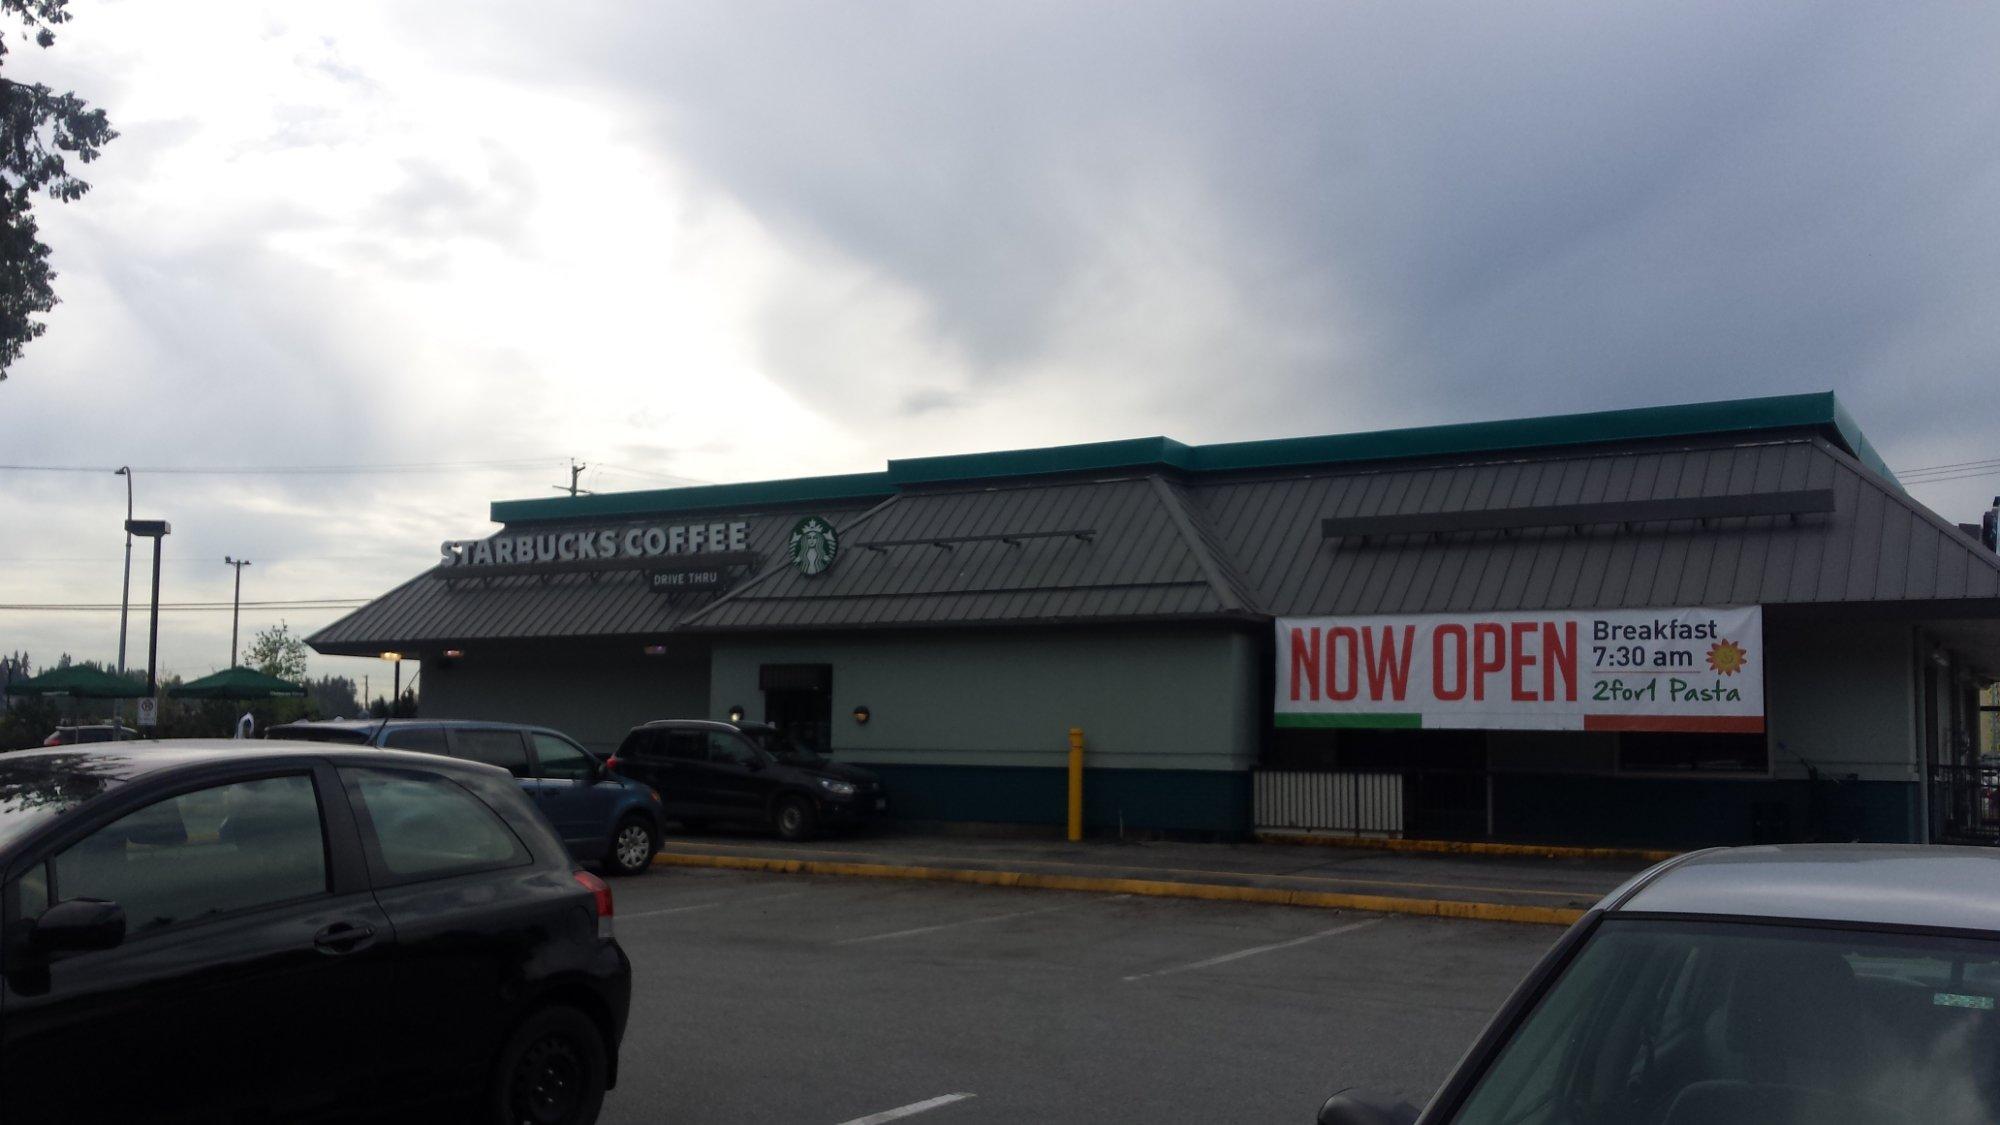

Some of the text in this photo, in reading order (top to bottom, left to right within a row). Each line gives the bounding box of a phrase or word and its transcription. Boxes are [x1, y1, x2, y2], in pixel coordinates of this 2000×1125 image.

[441, 522, 746, 567] STARBUCKS COFFEE
[654, 572, 717, 585] DRIVE THRU
[1593, 619, 1717, 640] Breakfast
[1290, 621, 1578, 702] NOW OPEN
[1593, 645, 1693, 667] 7:30 am
[1669, 677, 1741, 702] Pasta
